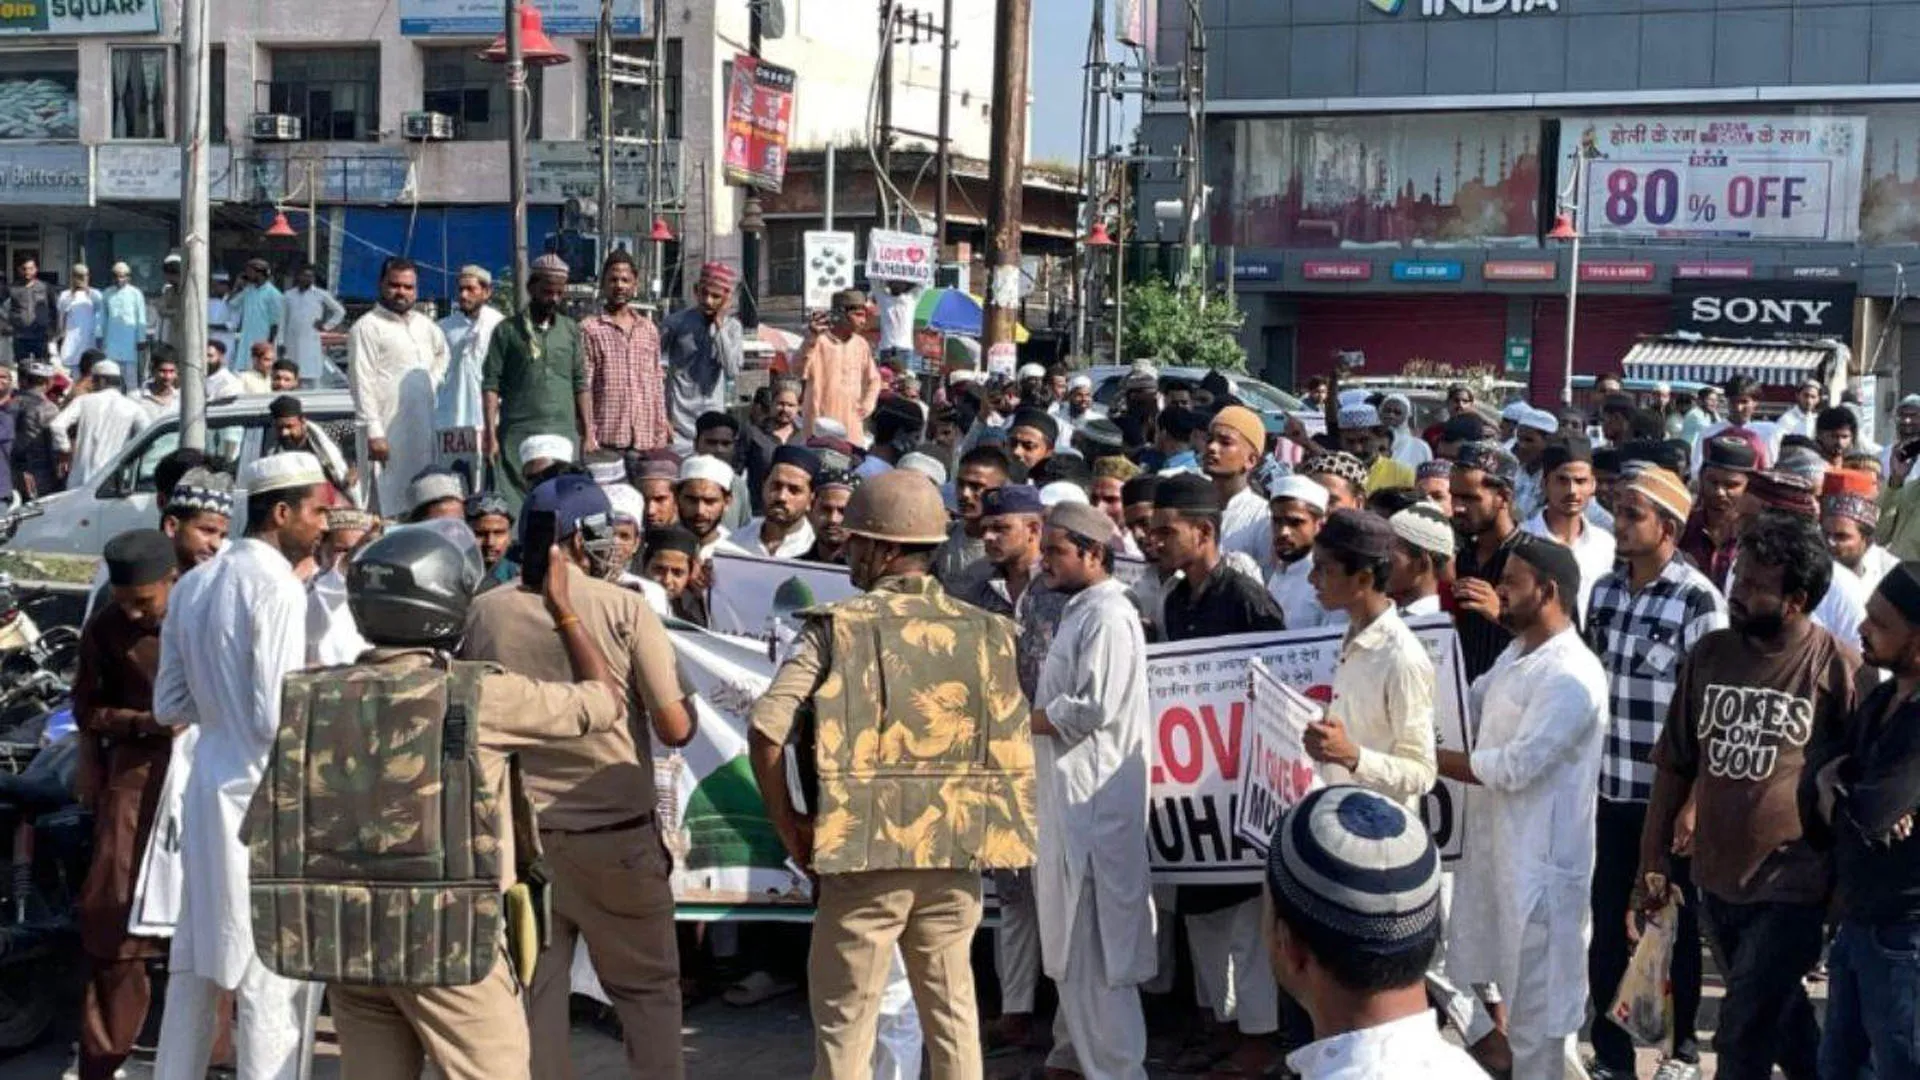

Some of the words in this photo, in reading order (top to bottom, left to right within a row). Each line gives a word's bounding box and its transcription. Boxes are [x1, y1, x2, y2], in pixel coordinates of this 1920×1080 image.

[1651, 122, 1668, 143] के
[1757, 123, 1774, 144] के
[1605, 168, 1679, 225] 80
[1688, 193, 1716, 223] %
[1728, 174, 1807, 219] OFF
[1692, 297, 1831, 325] SONY
[1698, 684, 1812, 746] JOKES
[1149, 702, 1247, 784] OV
[1726, 724, 1762, 746] ON
[1709, 738, 1777, 781] YOU
